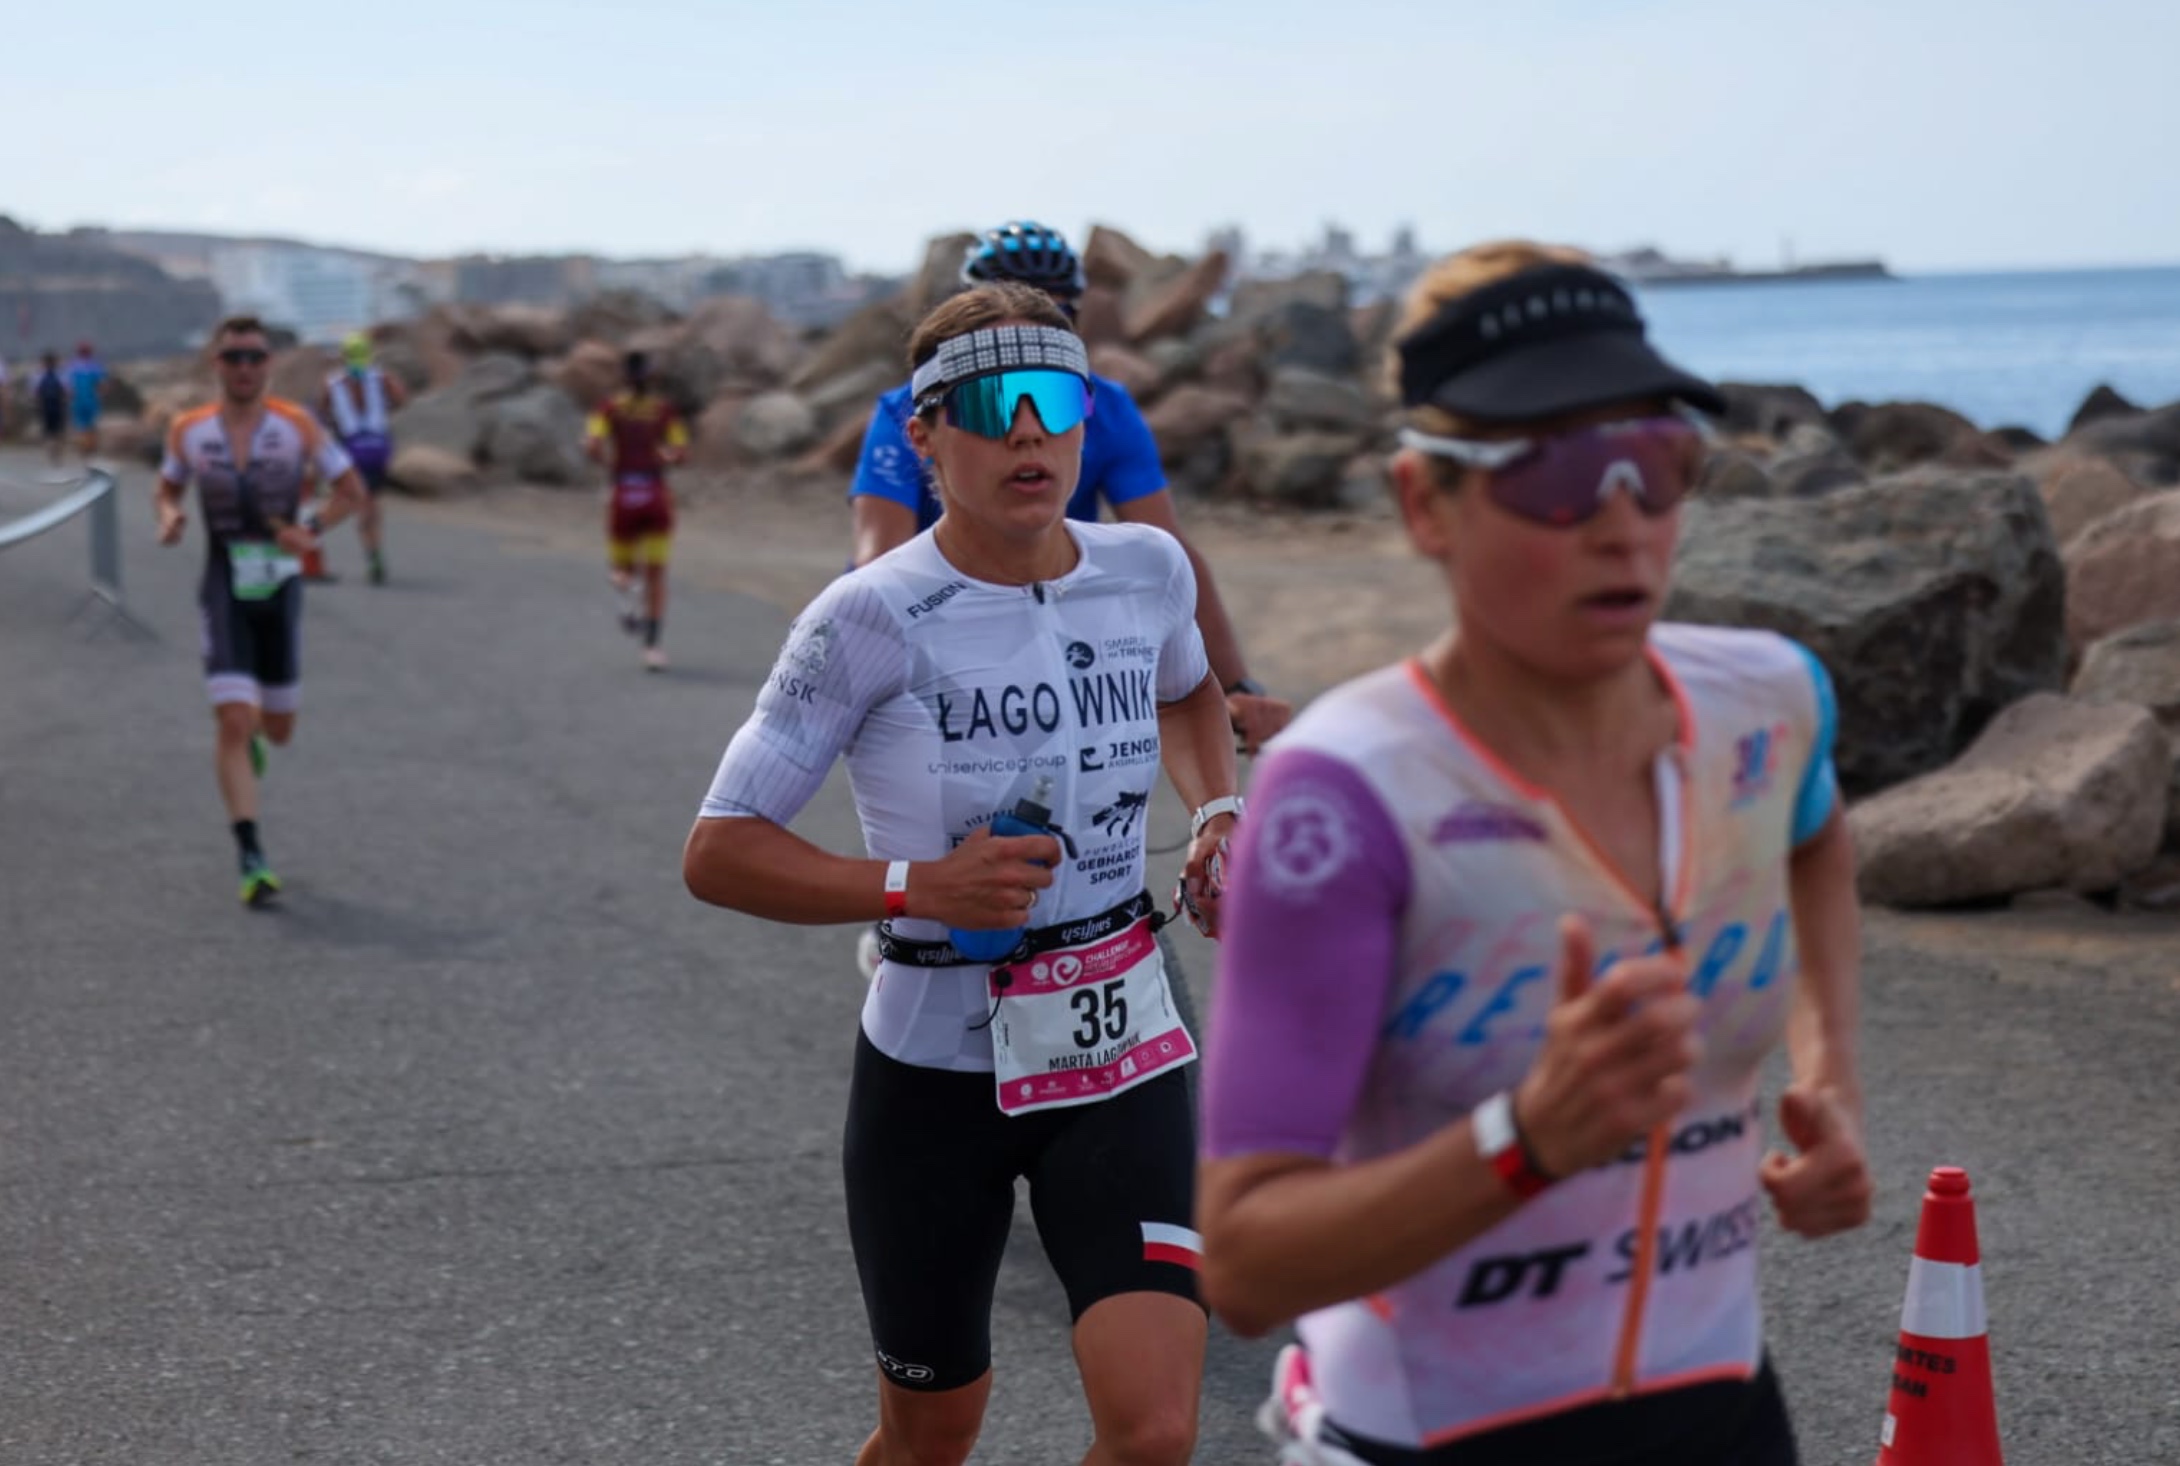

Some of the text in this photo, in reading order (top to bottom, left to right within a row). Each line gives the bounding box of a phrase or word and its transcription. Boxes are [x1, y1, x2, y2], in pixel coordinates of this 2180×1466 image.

[907, 580, 967, 619] FUSION
[937, 668, 1154, 743] ŁAGOWNIK
[927, 753, 1067, 775] uniservicegroup
[1089, 864, 1132, 885] SPORT
[1071, 979, 1129, 1049] 35
[1049, 1052, 1094, 1071] MARTA
[1454, 1240, 1592, 1310] DT
